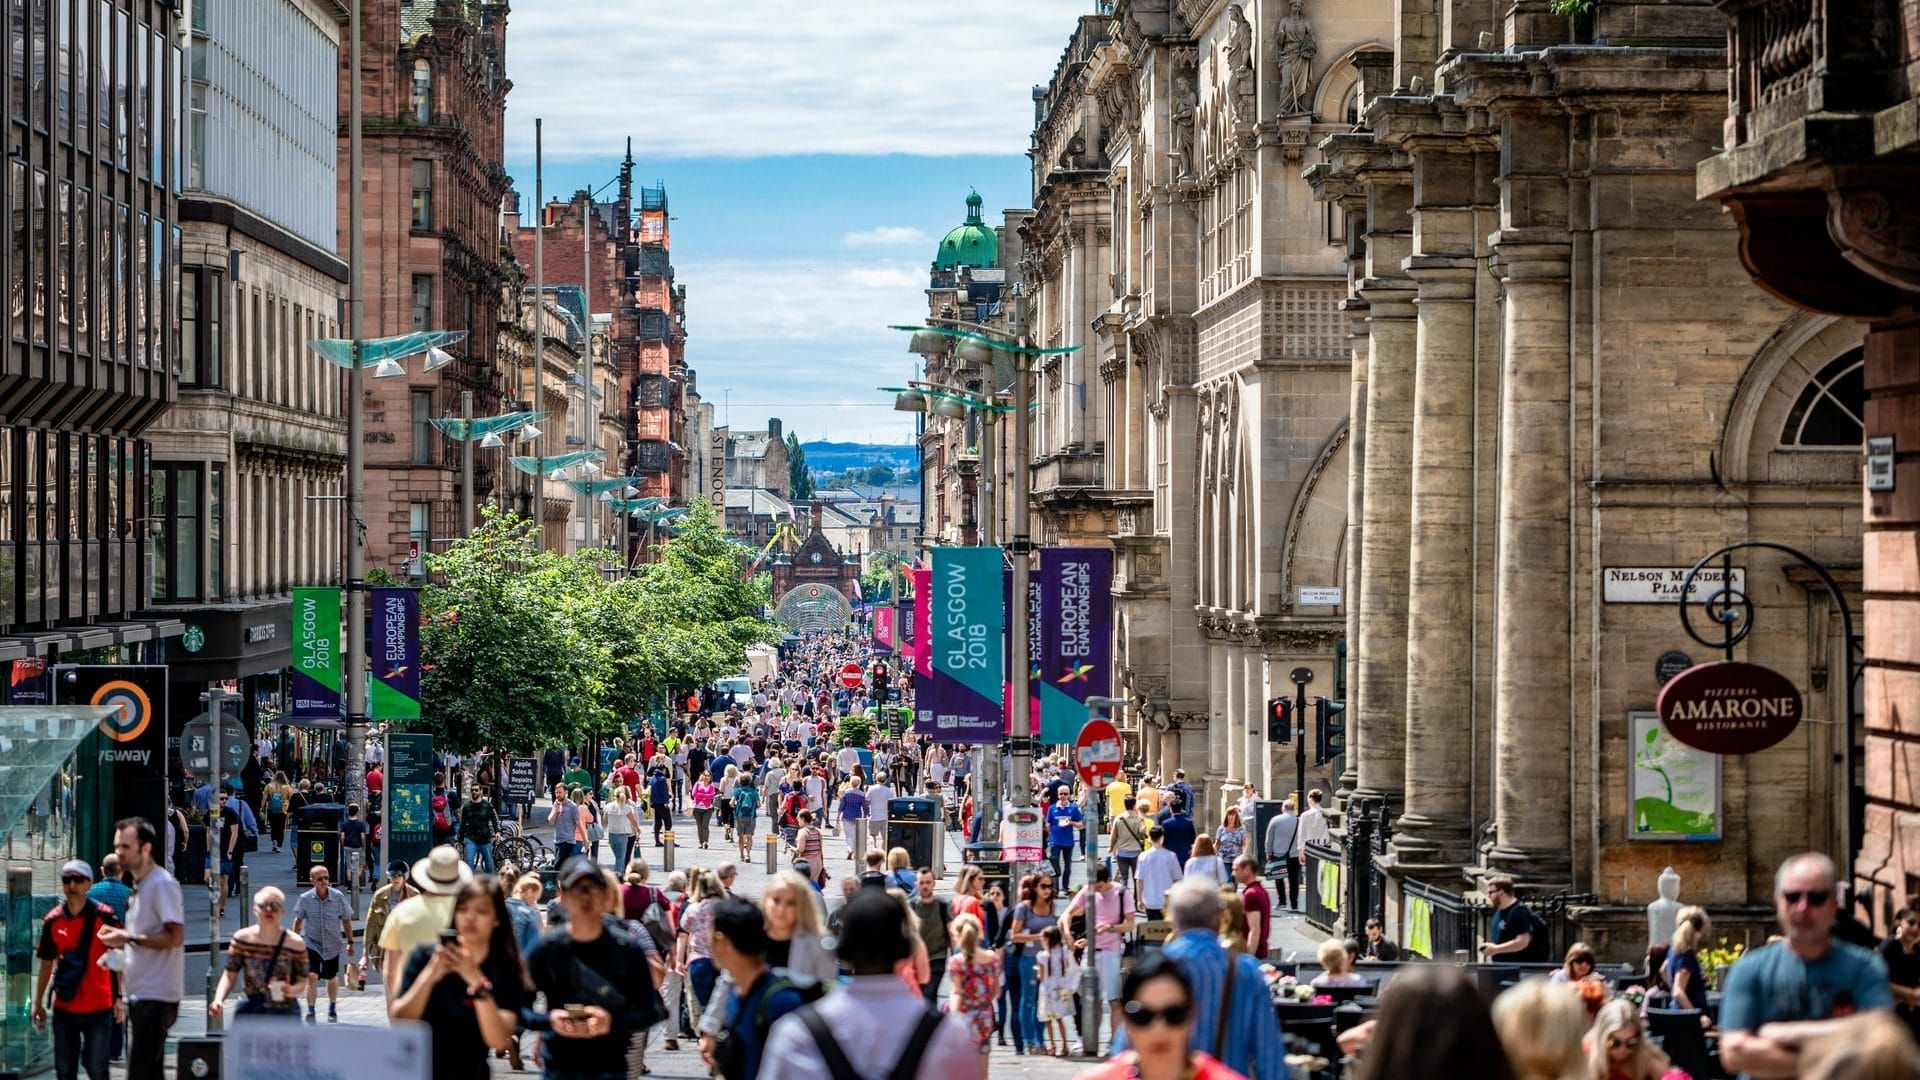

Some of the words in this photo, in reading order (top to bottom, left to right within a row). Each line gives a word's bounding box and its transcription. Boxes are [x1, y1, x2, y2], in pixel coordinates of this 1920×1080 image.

[1610, 570, 1663, 581] NELSON
[1671, 570, 1738, 581] MNDEA
[947, 563, 966, 669] GLASGOW
[1061, 562, 1078, 656] EUROPEAN
[1078, 562, 1090, 656] CHAMPIONSHIPS
[303, 598, 316, 668] GLASGOW
[386, 597, 397, 660] EUROPEAN
[397, 597, 405, 660] CHAMPIONSHIPS
[968, 624, 987, 669] 2018
[317, 638, 329, 668] 2018
[1670, 698, 1794, 720] AMARONE
[1704, 688, 1758, 696] PIZZERIA
[939, 717, 956, 725] HM
[1696, 720, 1768, 730] RISTORANTE
[514, 760, 531, 768] Apple
